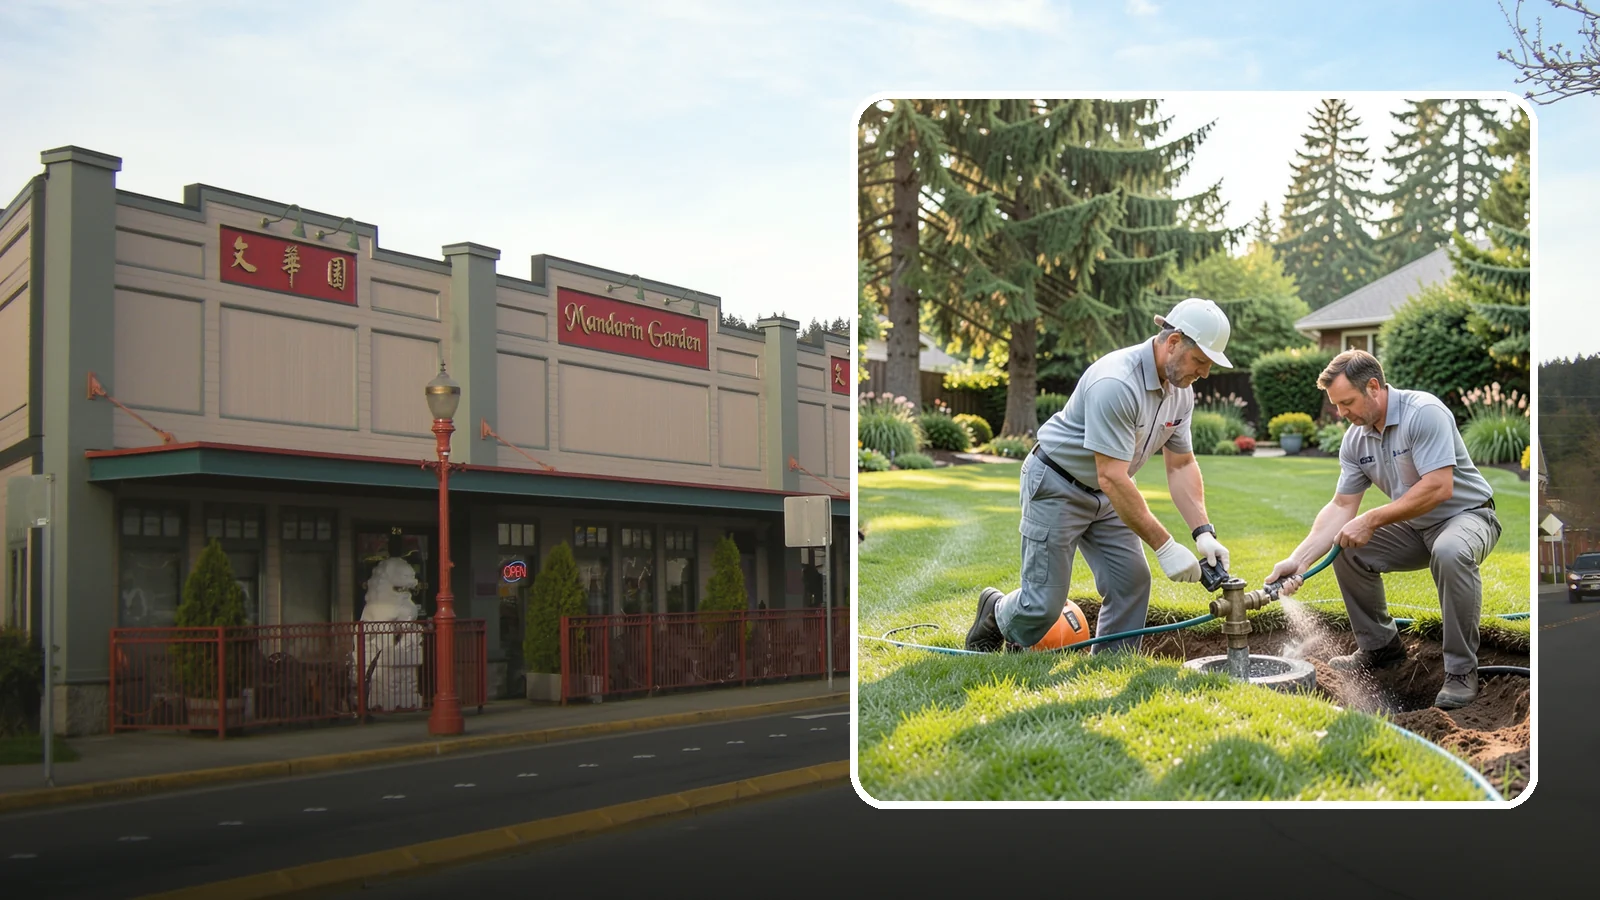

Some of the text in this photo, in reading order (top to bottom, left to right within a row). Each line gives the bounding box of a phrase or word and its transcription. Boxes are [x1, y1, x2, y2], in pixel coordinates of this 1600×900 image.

[230, 235, 346, 291] 文華園
[564, 301, 702, 352] Mandarin Garden
[503, 565, 527, 578] OPEN
